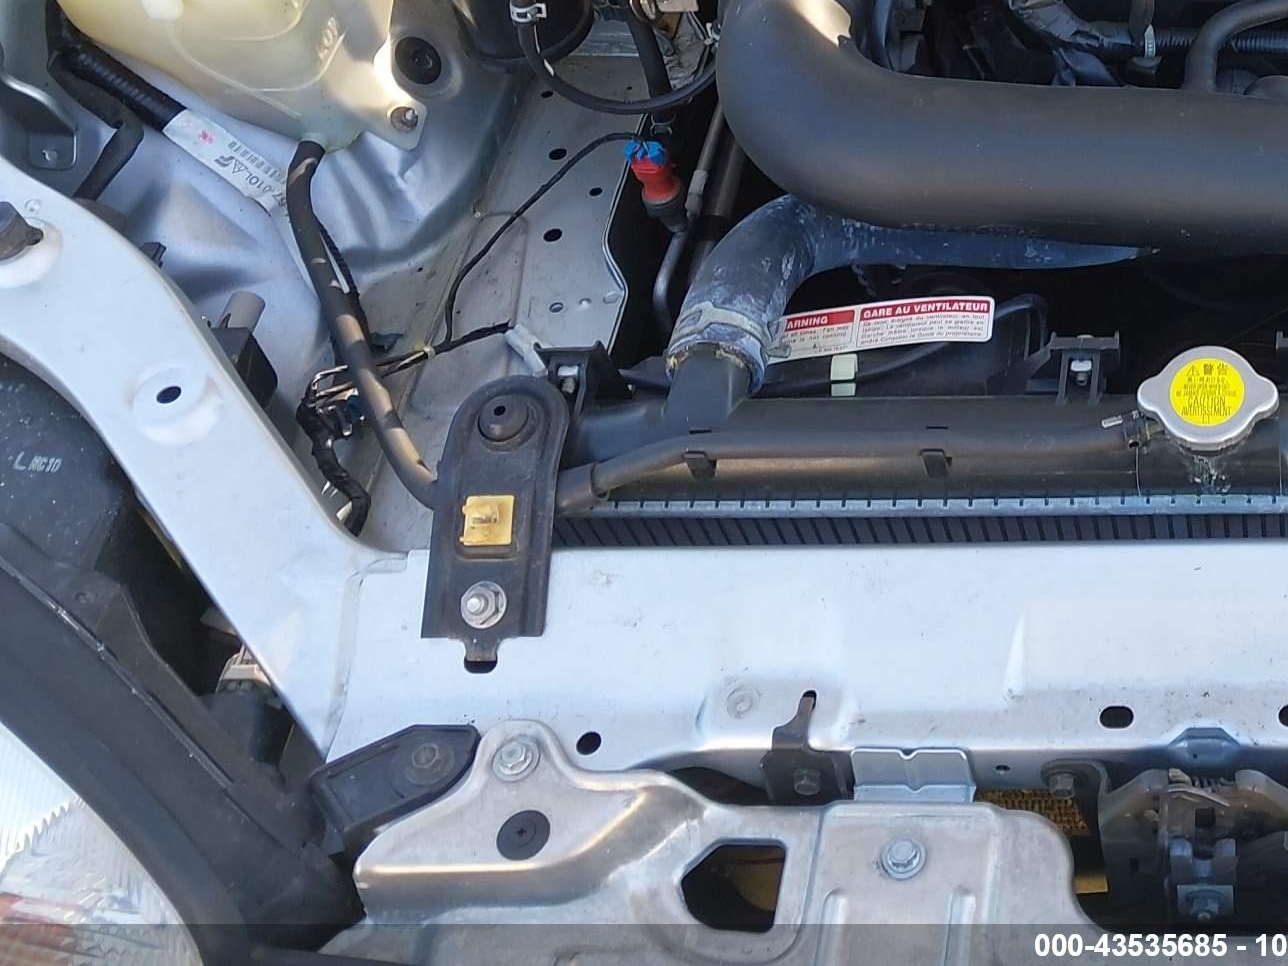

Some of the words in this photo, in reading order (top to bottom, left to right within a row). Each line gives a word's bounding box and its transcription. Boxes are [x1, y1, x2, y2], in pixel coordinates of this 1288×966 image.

[863, 308, 892, 319] GARE
[895, 306, 911, 315] AU
[914, 301, 988, 313] VENTILATEUR
[787, 316, 828, 330] ARNING
